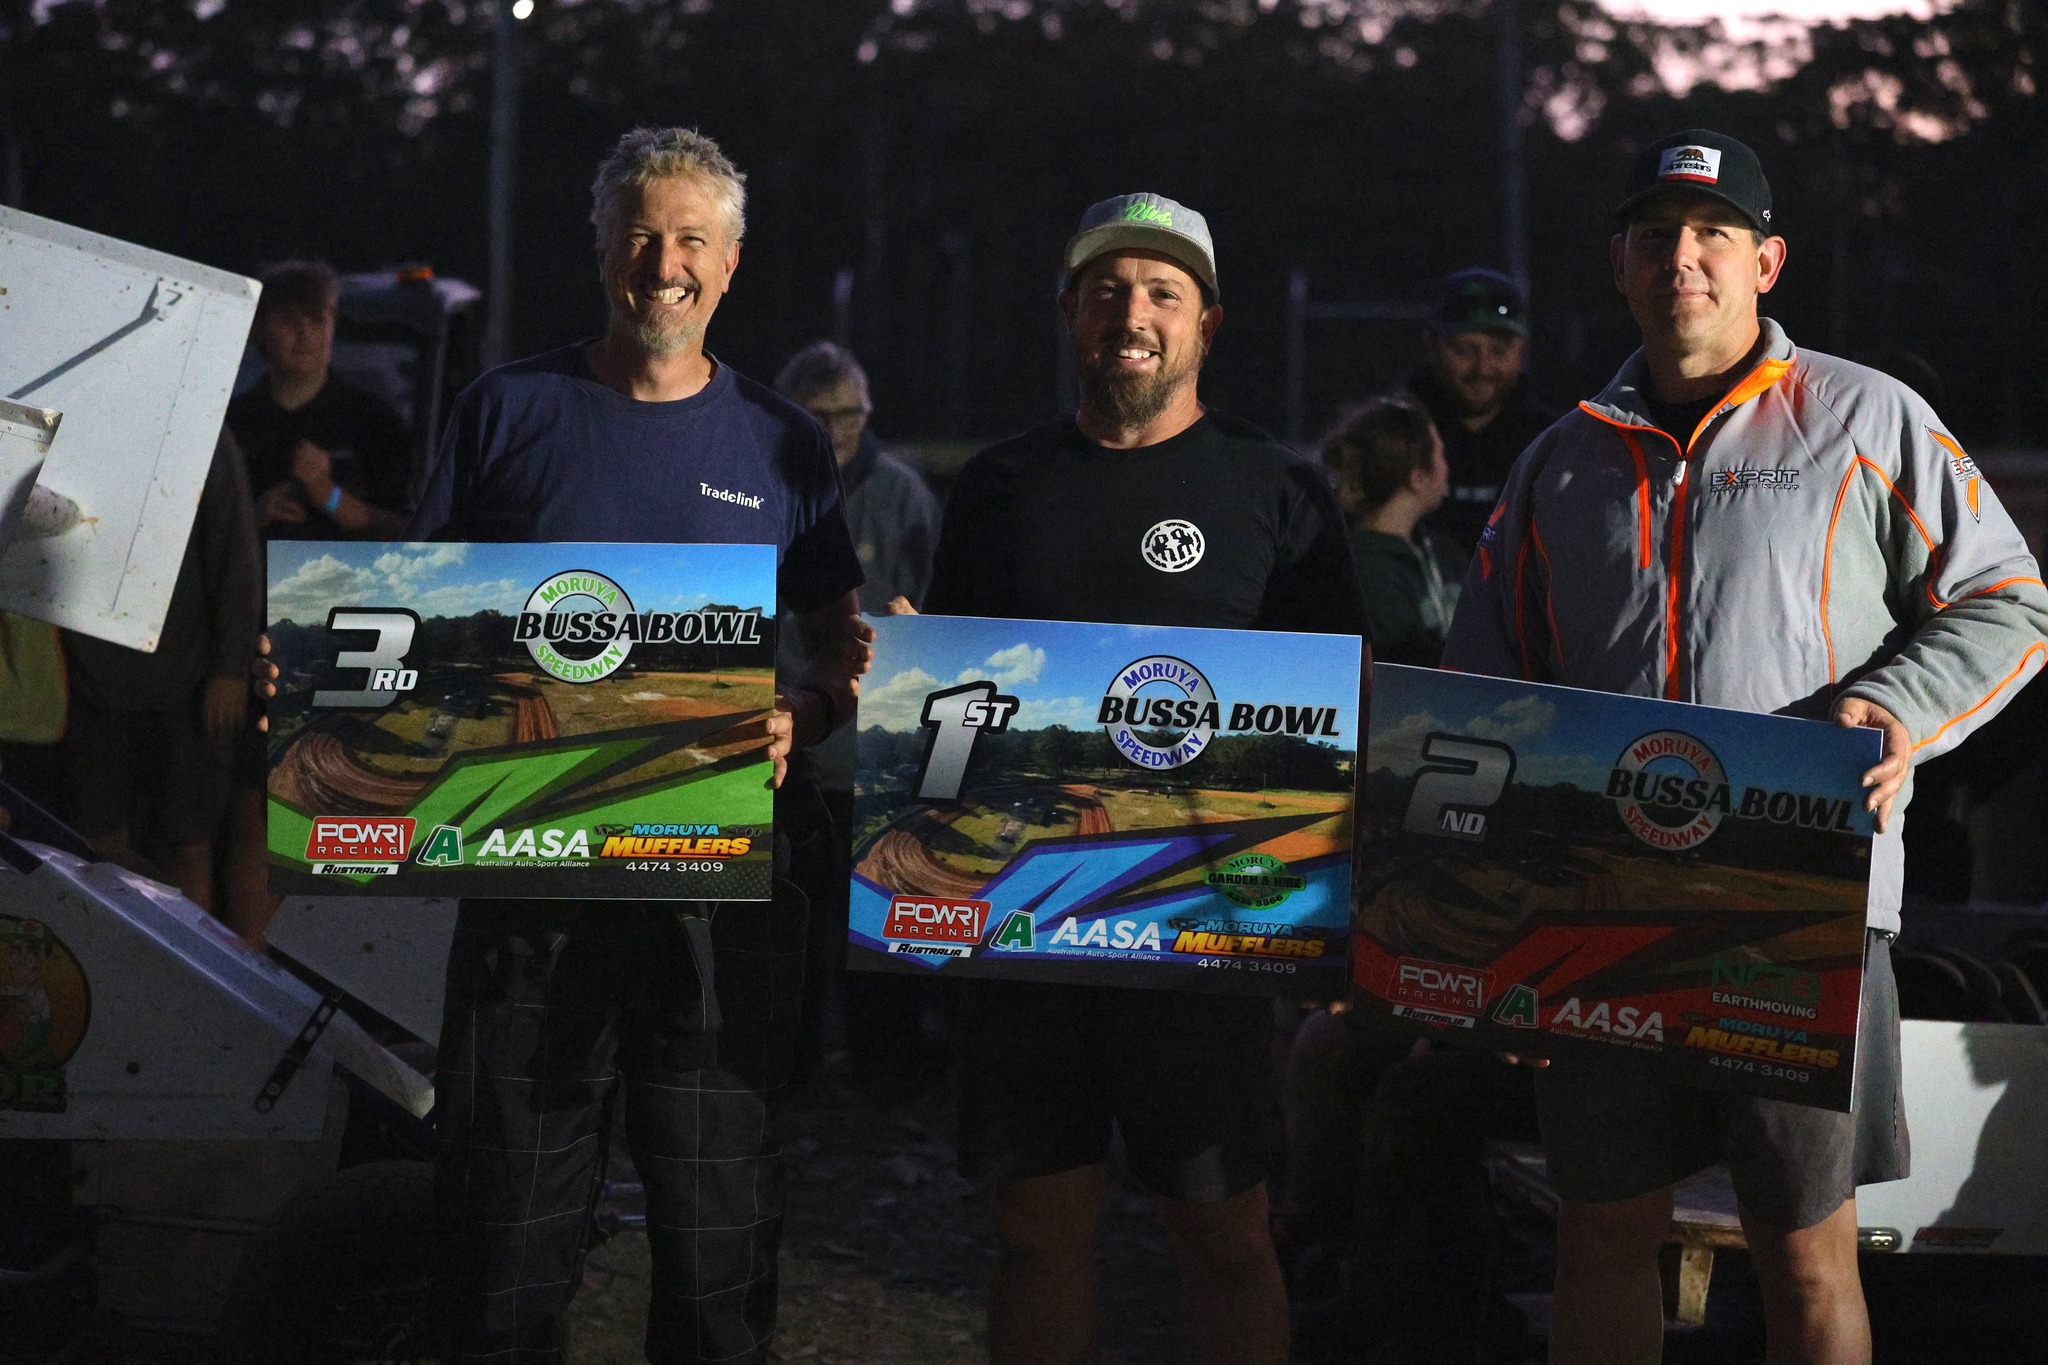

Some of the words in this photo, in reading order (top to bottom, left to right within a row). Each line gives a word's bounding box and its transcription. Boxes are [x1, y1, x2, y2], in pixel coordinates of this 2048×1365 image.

[1711, 469, 1799, 486] EXPRIT
[700, 482, 765, 510] Tradelink
[540, 577, 619, 605] MORUYA
[514, 612, 642, 643] BUSSA
[645, 612, 761, 645] BOWL
[535, 644, 624, 681] SPEEDWAY
[1122, 662, 1200, 693] MORUYA
[1097, 696, 1220, 731] BUSSA
[1227, 702, 1341, 737] BOWL
[1115, 729, 1204, 767] SPEEDWAY
[1632, 737, 1712, 772] MORUYA
[1603, 767, 1733, 816] BUSSA
[1737, 786, 1856, 833] BOWL
[631, 823, 720, 836] MORUYA
[1623, 804, 1713, 848] SPEEDWAY
[317, 846, 398, 855] RACING
[476, 828, 590, 858] AASA
[600, 836, 751, 858] MUFFLERS
[475, 859, 513, 868] Australian
[515, 859, 558, 868] Auto-Sport
[560, 860, 590, 868] Alliance
[625, 861, 671, 872] 4474
[676, 861, 724, 872] 3409
[1208, 872, 1258, 887] GARDEN
[894, 925, 972, 938] RACING
[1049, 916, 1162, 951] AASA
[1204, 920, 1295, 936] MORUYA
[1047, 948, 1084, 956] Australian
[1086, 950, 1129, 959] Auto-Sport
[1130, 953, 1161, 961] Alliance
[1172, 930, 1326, 958] MUFFLERS
[1197, 959, 1243, 971] 4474
[1249, 961, 1296, 974] 3409
[1398, 988, 1475, 1008] RACING
[1712, 991, 1817, 1020] EARTHMOVING
[1551, 996, 1664, 1043] AASA
[1718, 1017, 1808, 1044] MORUYA
[1684, 1025, 1841, 1069] MUFFLERS
[1708, 1056, 1755, 1073] 4474
[1760, 1064, 1810, 1083] 3409
